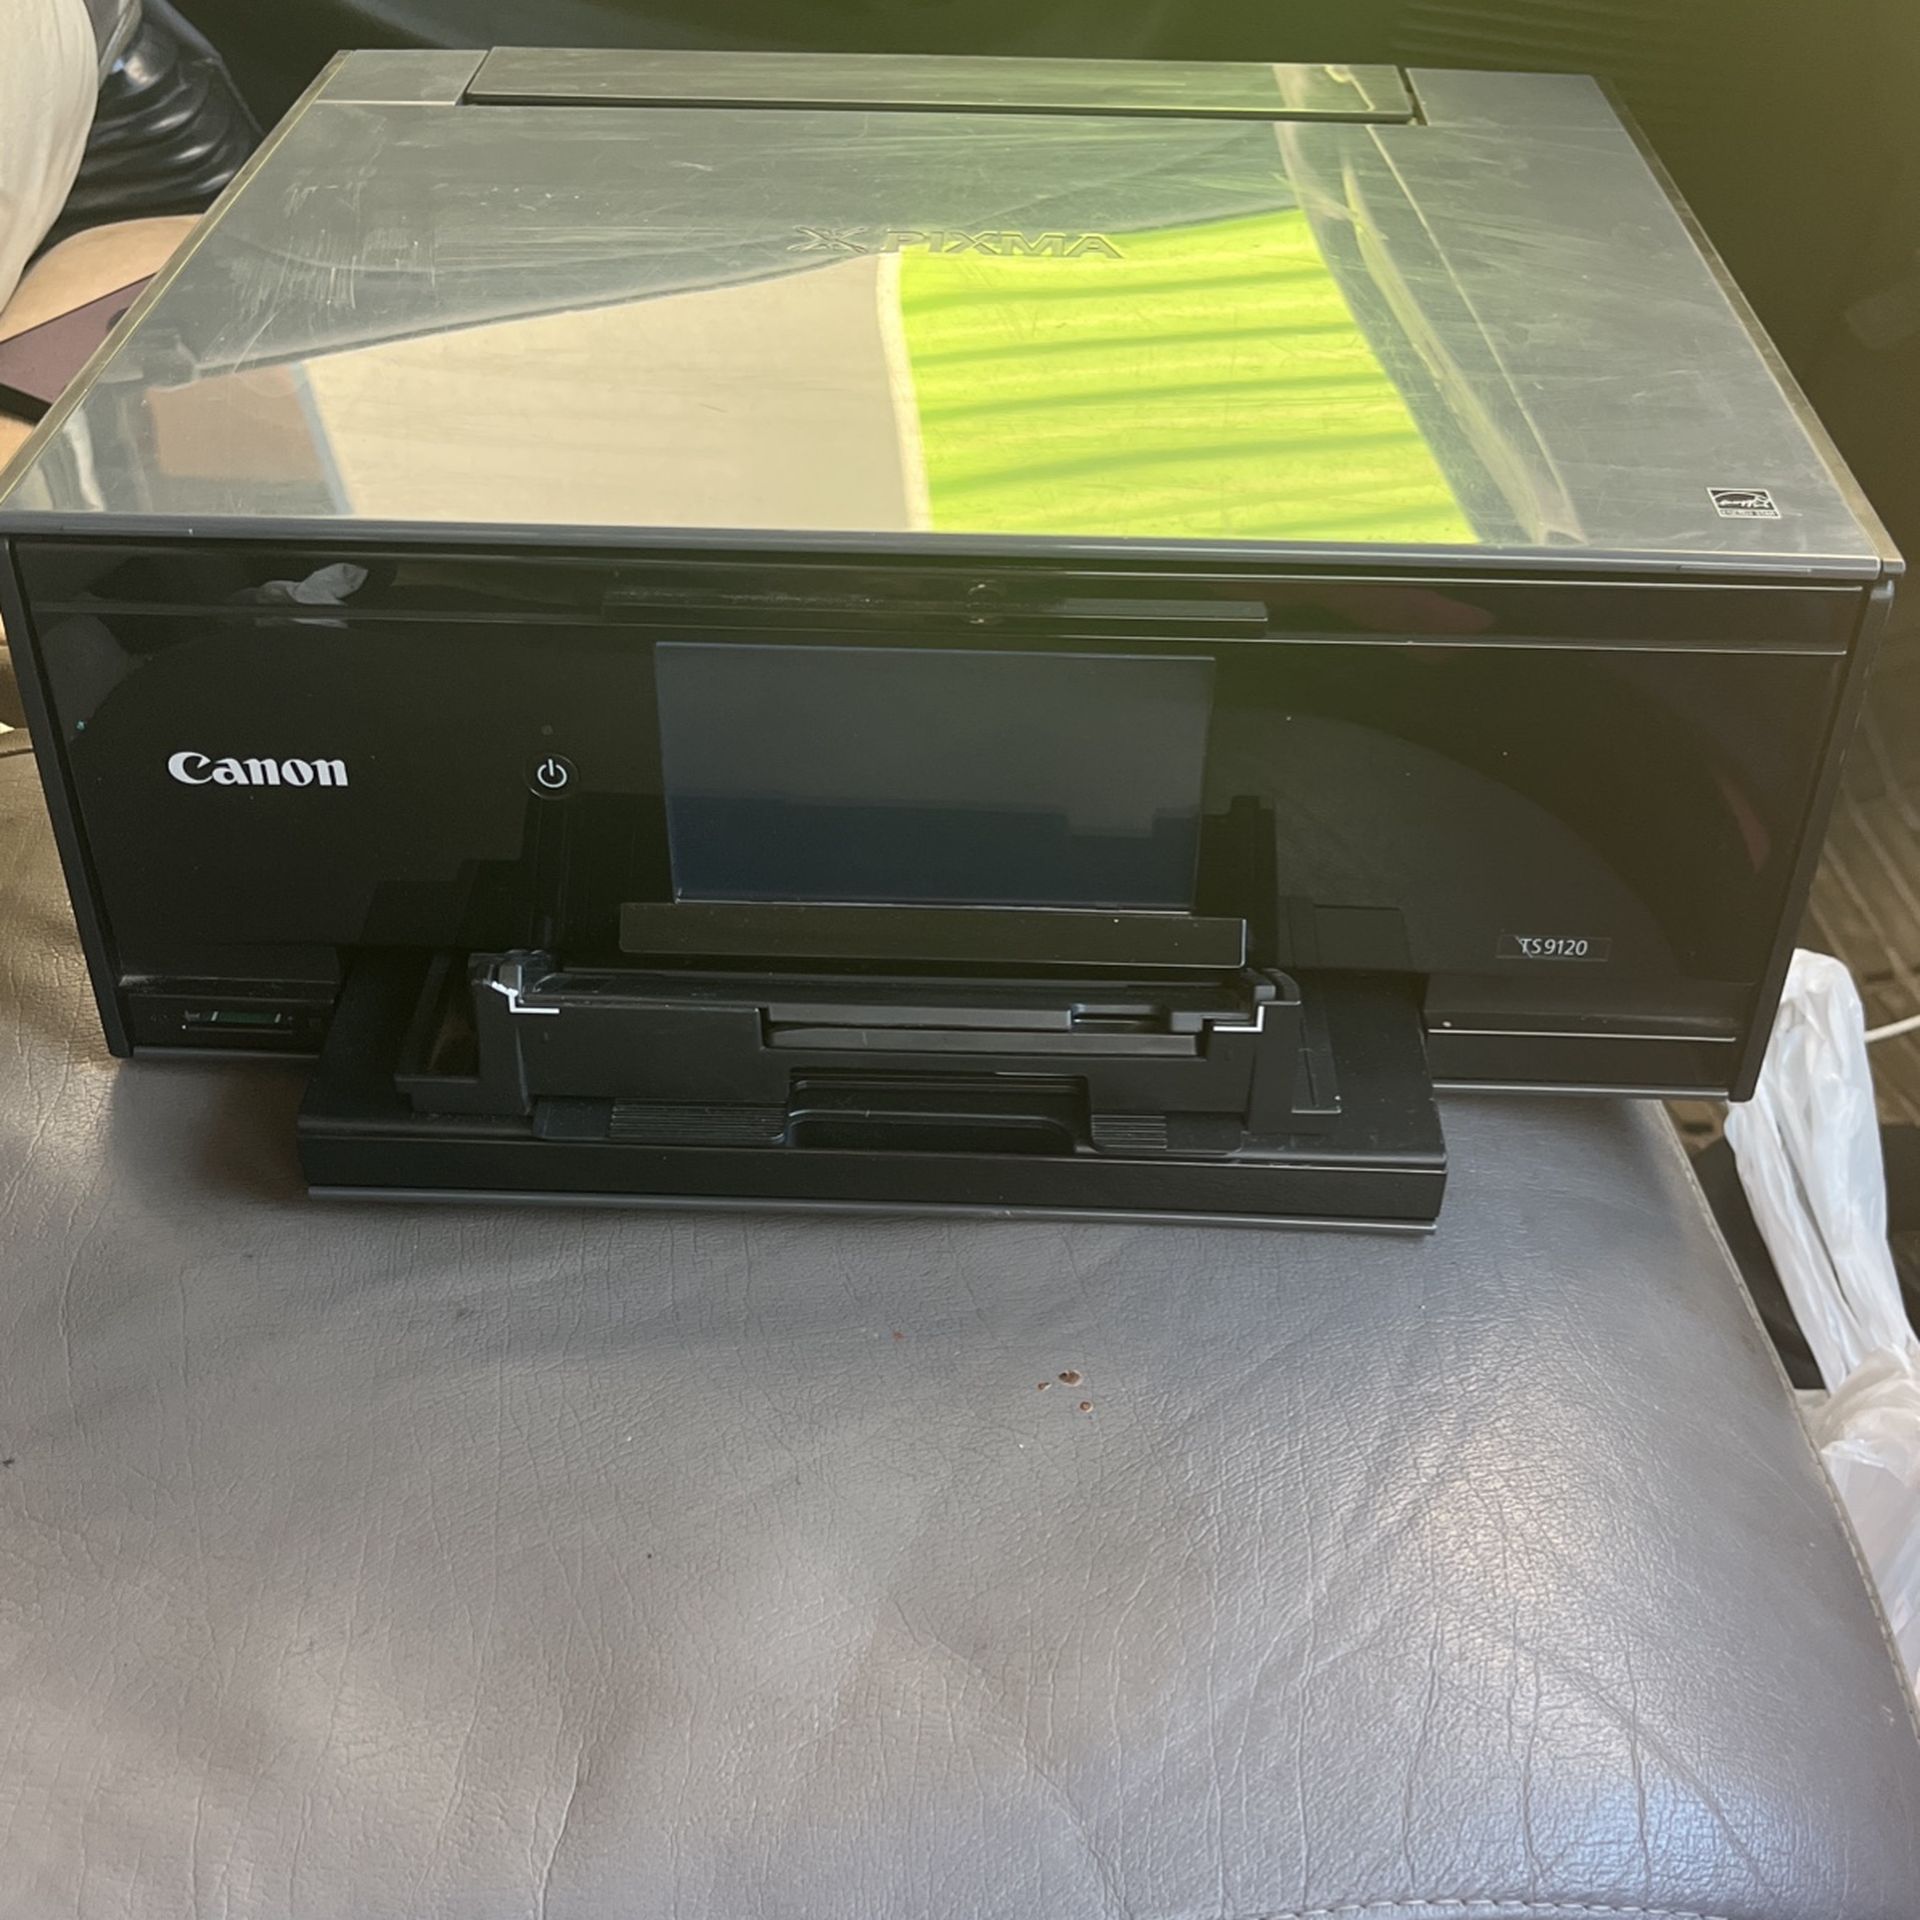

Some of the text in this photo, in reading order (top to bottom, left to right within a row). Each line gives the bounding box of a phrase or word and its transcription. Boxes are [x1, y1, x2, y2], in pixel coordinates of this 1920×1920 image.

[883, 229, 1124, 259] PIXMA
[167, 751, 350, 787] Canon
[1518, 937, 1589, 957] TS9120
